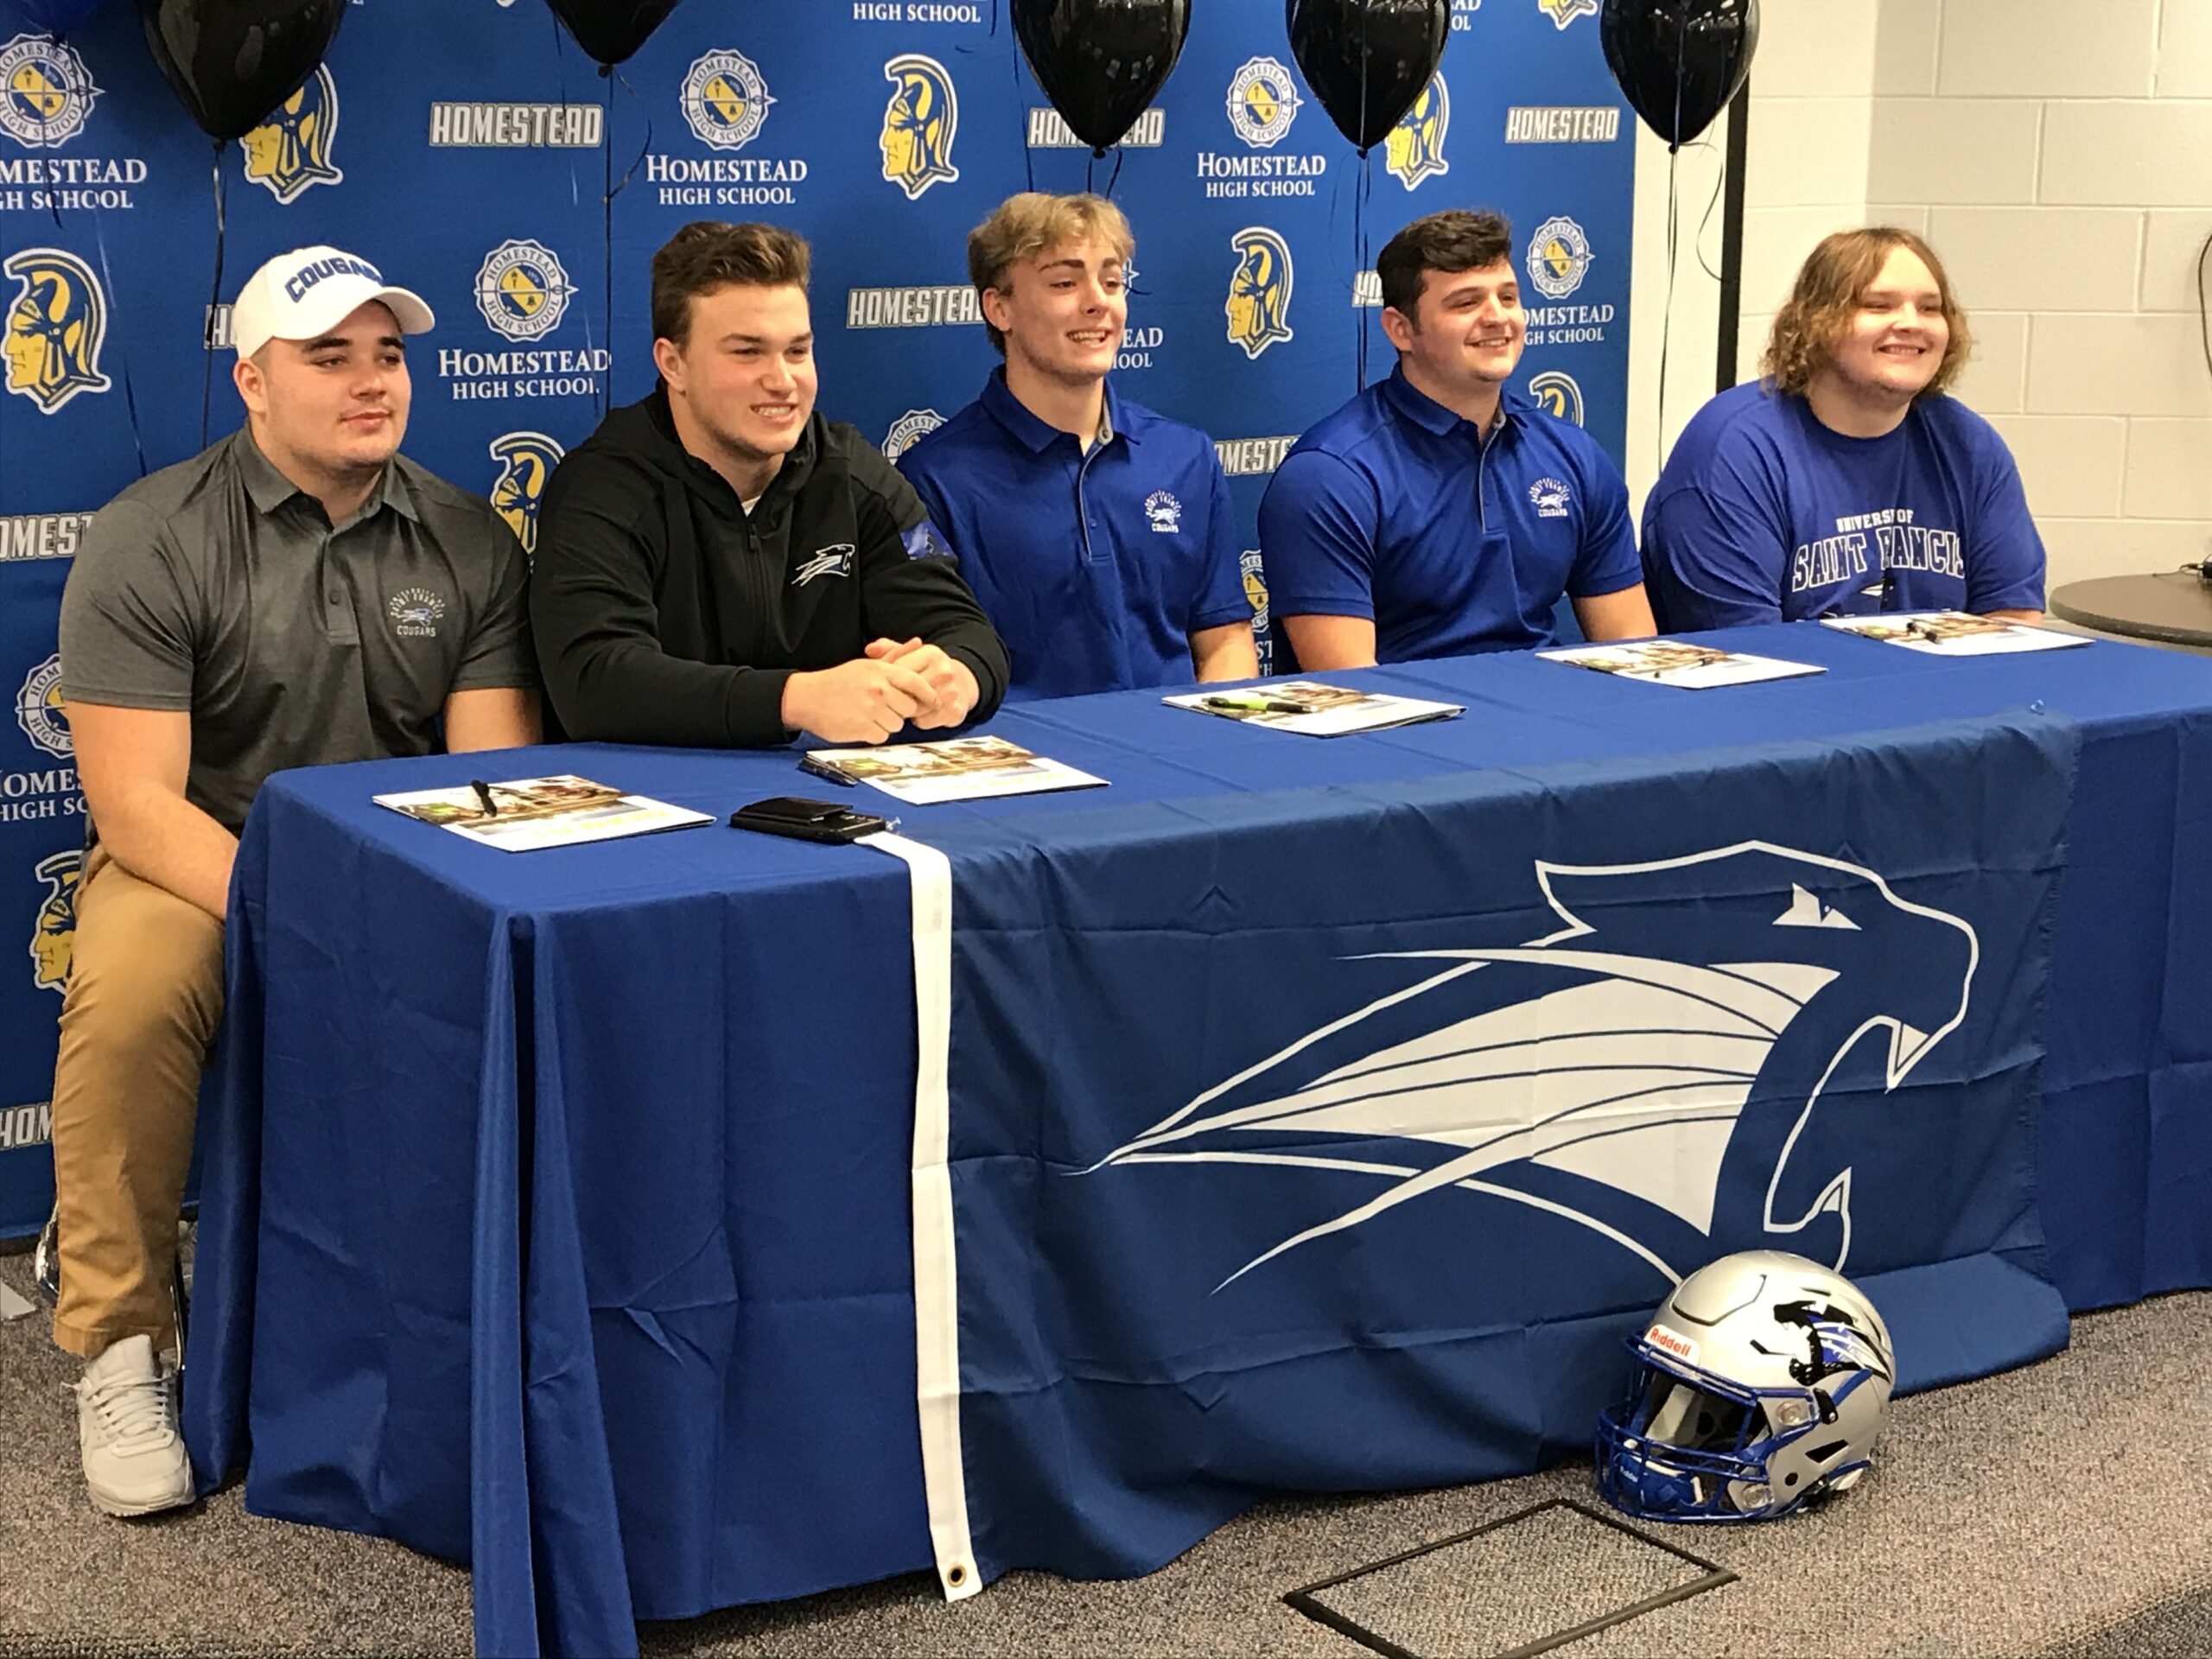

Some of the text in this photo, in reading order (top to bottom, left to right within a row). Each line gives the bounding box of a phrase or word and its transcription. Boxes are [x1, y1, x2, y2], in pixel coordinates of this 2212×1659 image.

[853, 3, 982, 23] HIGH SCHOOL
[692, 57, 759, 89] HOMESTEAD
[1236, 64, 1289, 94] HOMESTEAD
[430, 102, 603, 147] HOMESTEAD
[691, 106, 760, 142] HIGH SCHOOL
[1506, 108, 1620, 142] HOMESTEAD
[645, 155, 809, 183] HOMESTEAD
[1197, 152, 1326, 178] HOMESTEAD
[31, 189, 134, 210] SCHOOL
[658, 187, 797, 206] HIGH SCHOOL
[1205, 180, 1316, 199] HIGH SCHOOL
[486, 248, 558, 282] HOMESTEAD
[486, 299, 560, 334] HIGH SCHOOL
[1548, 327, 1605, 345] SCHOOL
[438, 347, 612, 378] HOMESTEAD
[452, 377, 601, 401] HIGH SCHOOL
[1897, 508, 1914, 524] OF
[1792, 532, 1868, 593] SAINT
[30, 716, 60, 747] HIGH
[1649, 1327, 1693, 1357] Riddell
